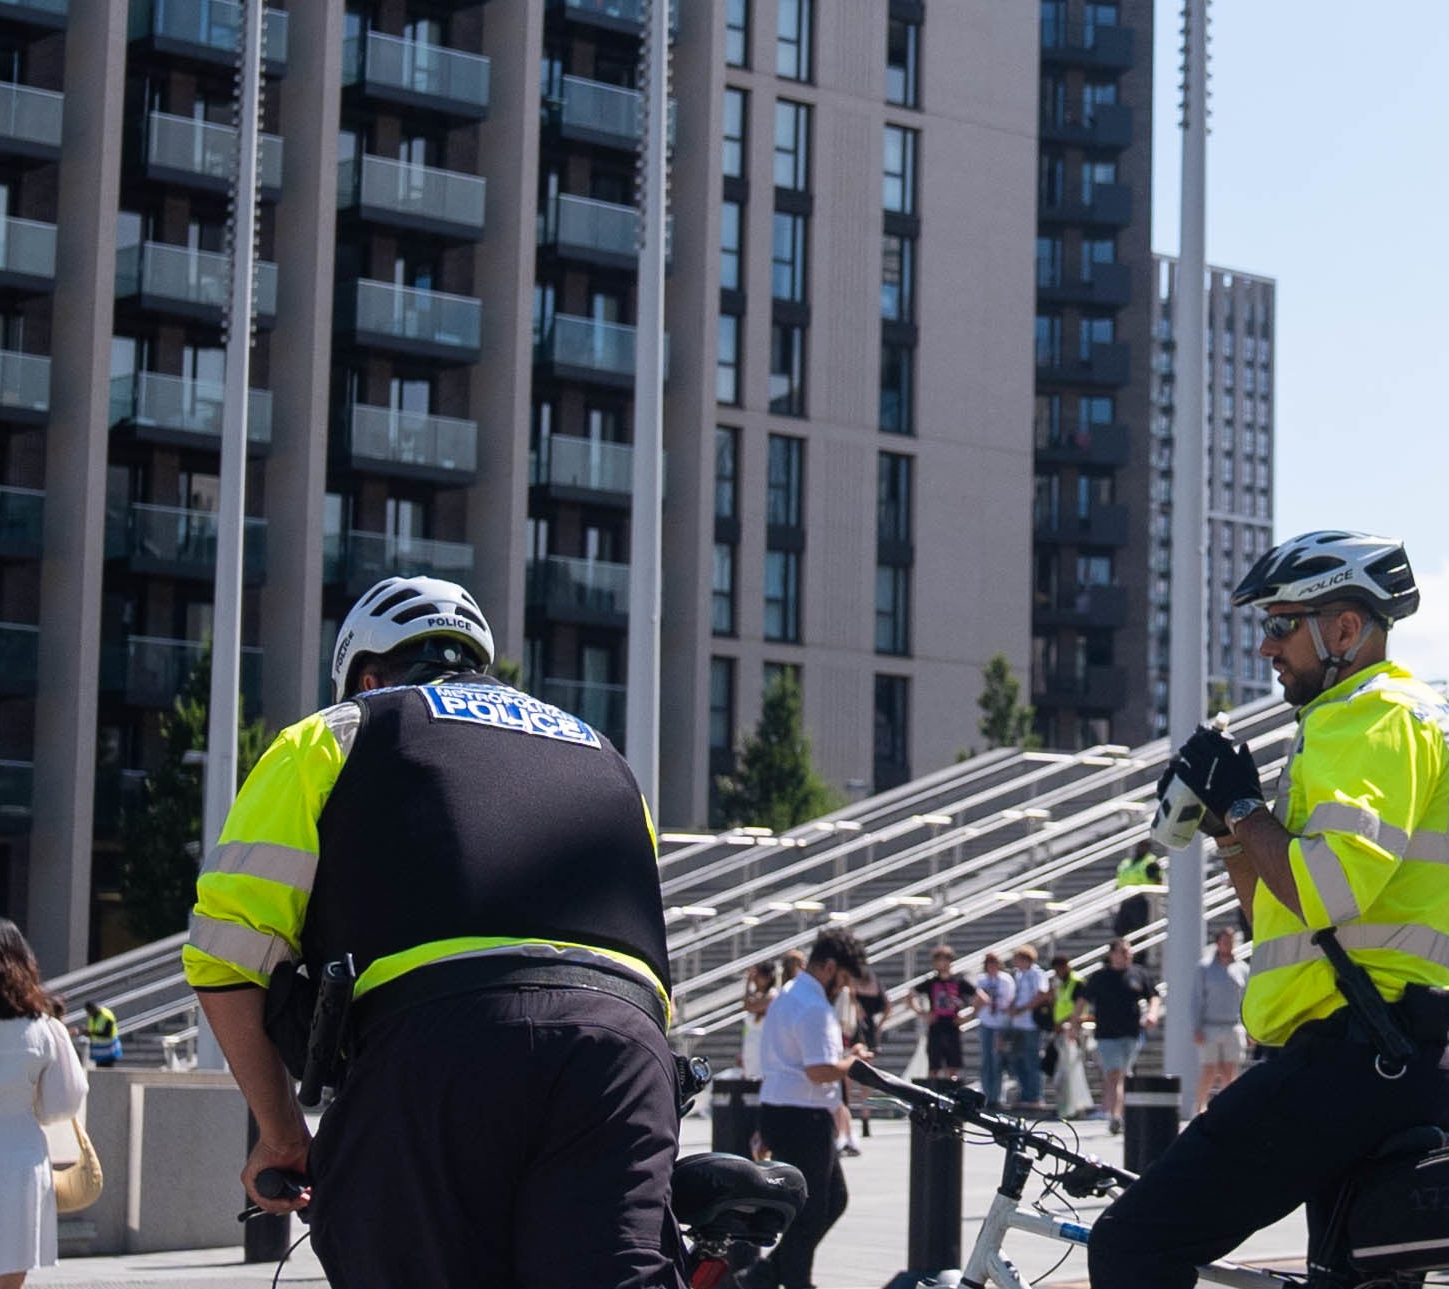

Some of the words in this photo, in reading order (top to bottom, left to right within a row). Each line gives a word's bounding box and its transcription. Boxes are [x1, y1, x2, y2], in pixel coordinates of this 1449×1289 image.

[1297, 568, 1355, 598] POLICE
[427, 617, 472, 632] POLICE
[440, 696, 587, 741] POLICE
